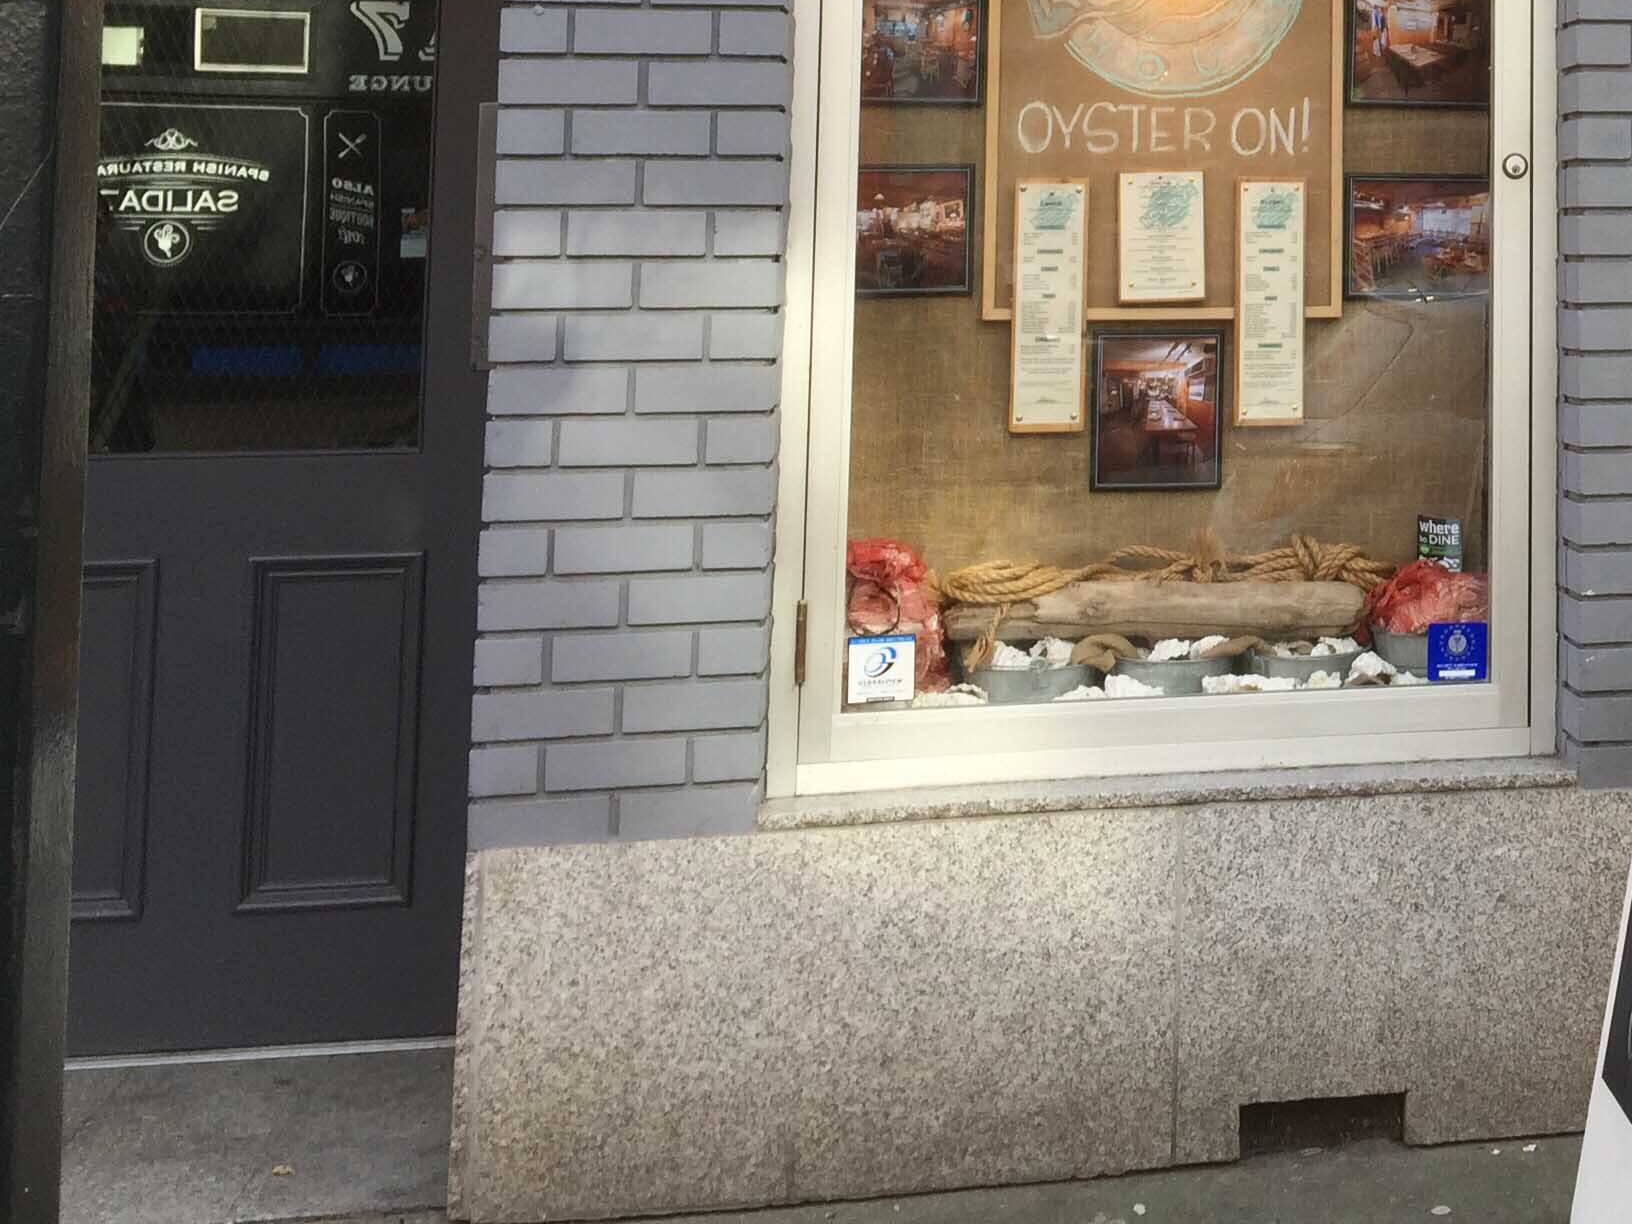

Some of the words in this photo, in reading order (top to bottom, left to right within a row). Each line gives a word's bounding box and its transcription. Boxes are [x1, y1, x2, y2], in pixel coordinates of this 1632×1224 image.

[1018, 101, 1216, 154] OYSTER
[1231, 97, 1310, 156] ON!
[1419, 520, 1460, 534] where
[1429, 534, 1460, 545] DINE
